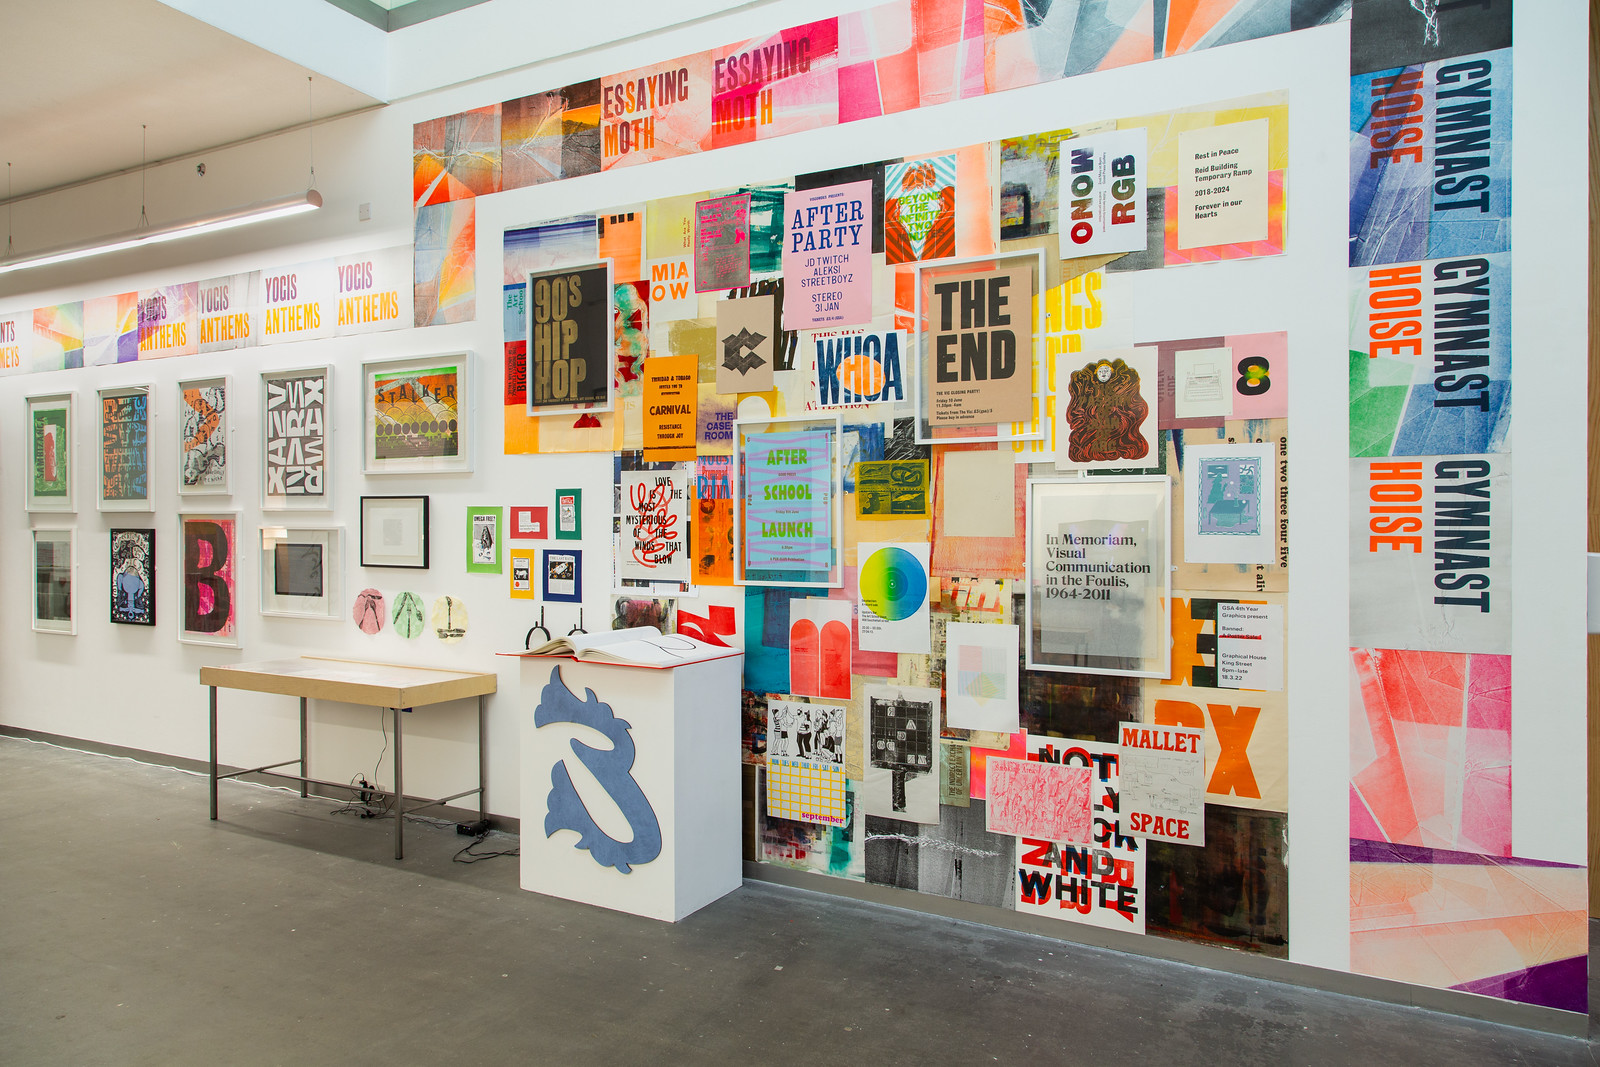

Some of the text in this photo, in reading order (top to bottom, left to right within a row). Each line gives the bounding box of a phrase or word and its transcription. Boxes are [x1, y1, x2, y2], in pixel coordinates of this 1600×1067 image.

[715, 37, 810, 93] ESSAYING
[604, 68, 688, 118] ESSAYING
[715, 89, 773, 134] MOTH
[1370, 70, 1424, 169] HOISE
[604, 116, 654, 157] MOTH
[1434, 59, 1492, 213] GYMNAST
[1195, 152, 1210, 160] Rest
[1219, 148, 1239, 157] Peace
[1195, 162, 1238, 174] Reid Building
[1195, 168, 1252, 184] Temporary Ramp
[1111, 154, 1136, 225] RGB
[1195, 186, 1230, 197] 2018-2024
[898, 191, 941, 206] BEYOND
[1195, 201, 1220, 211] Forever
[1222, 200, 1229, 208] in
[791, 200, 864, 230] AFTER
[908, 202, 928, 214] THE
[1195, 210, 1218, 220] Hearts
[907, 220, 932, 232] TWO
[791, 224, 863, 254] PARTY
[805, 254, 849, 268] JD TWITCH
[652, 262, 688, 282] MIA
[813, 266, 840, 276] ALEKSI
[801, 274, 853, 288] STREETBOYZ
[652, 282, 688, 302] OW
[812, 292, 842, 302] STEREO
[338, 290, 398, 326] ANTHEMS
[815, 302, 840, 312] 31 JAN
[934, 276, 1010, 331] THE
[1369, 265, 1422, 358] HOISE
[265, 302, 320, 334] ANTHEMS
[140, 322, 186, 351] ANTHEMS
[200, 312, 250, 344] ANTHEMS
[1434, 258, 1490, 412] GYMNAST
[535, 320, 578, 361] HIP
[937, 330, 1016, 383] END
[517, 353, 526, 392] BIGGER
[816, 333, 904, 405] WHOA
[1236, 356, 1271, 396] 8
[535, 358, 586, 401] HOP
[378, 384, 455, 404] STALKER
[650, 404, 691, 416] CARNIVAL
[716, 412, 733, 420] THE
[704, 432, 733, 440] ROOM
[766, 448, 808, 466] AFTER
[655, 476, 671, 486] LOVE
[650, 490, 682, 500] IS THE
[764, 484, 812, 500] SCHOOL
[638, 502, 656, 512] MOST
[1369, 462, 1422, 553] HOISE
[626, 515, 666, 525] MYSTERIOUS
[633, 528, 667, 538] OF THE
[762, 522, 813, 538] LAUNCH
[1434, 460, 1490, 613] GYMNAST
[634, 540, 682, 552] WINDS THAT
[1046, 533, 1137, 547] In Memoriam,
[654, 554, 672, 564] BLOW
[1047, 548, 1086, 558] Visual
[1280, 546, 1288, 568] five
[1046, 560, 1150, 574] Communication
[185, 521, 230, 632] B
[1046, 574, 1129, 588] in the Foulis,
[1046, 588, 1110, 600] 1964-2011
[1222, 612, 1246, 620] Graphics
[1122, 727, 1200, 754] MALLET
[802, 812, 844, 824] september
[1130, 812, 1190, 840] SPACE
[1019, 868, 1138, 914] WHITE
